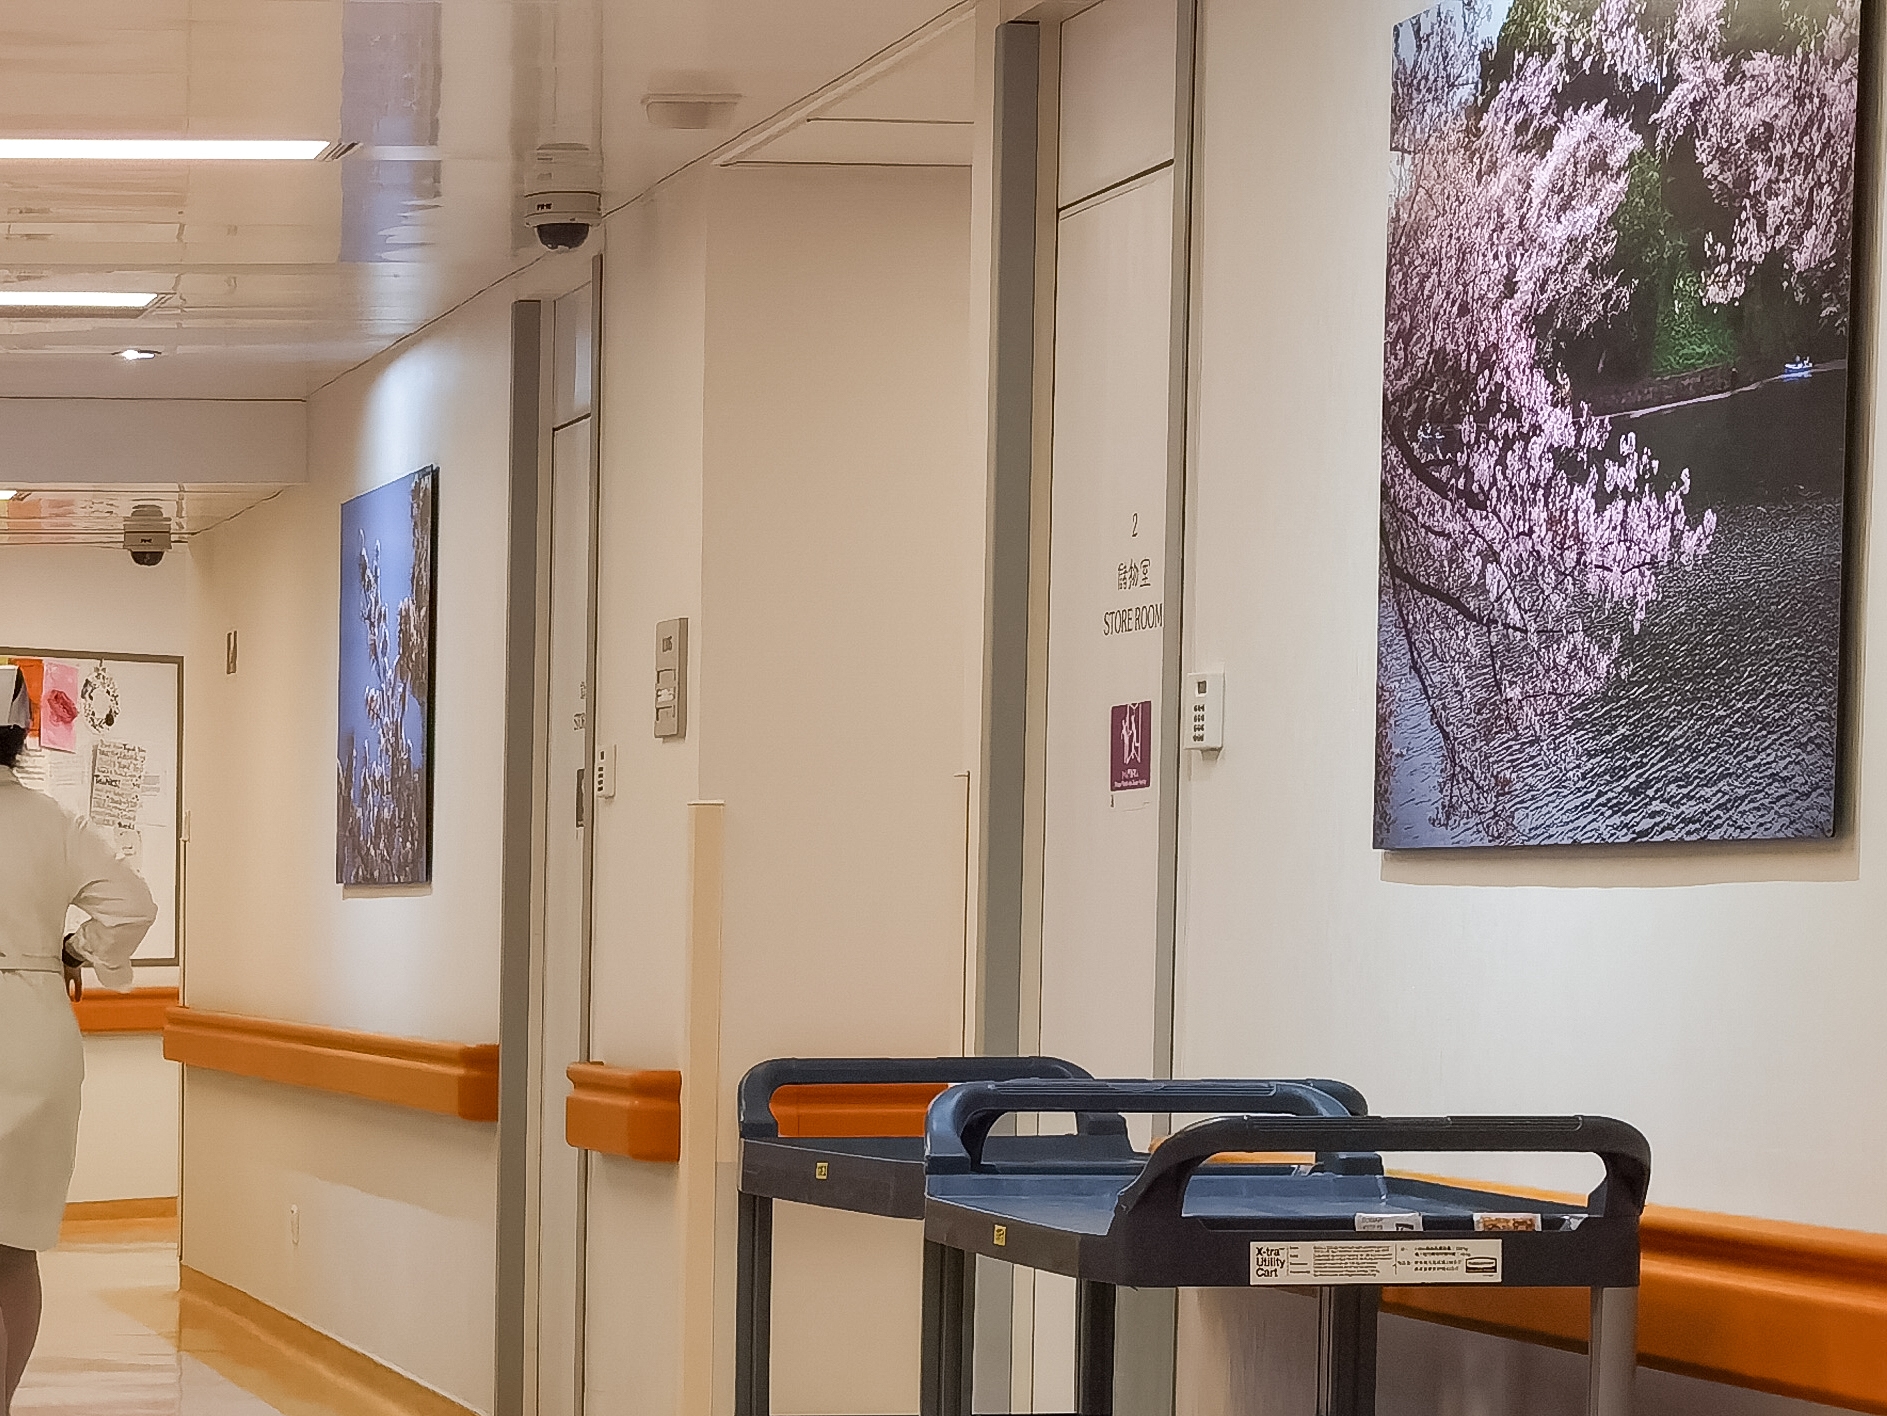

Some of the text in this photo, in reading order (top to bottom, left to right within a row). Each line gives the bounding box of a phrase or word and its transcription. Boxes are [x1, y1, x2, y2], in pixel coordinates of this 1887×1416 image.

[1132, 513, 1138, 537] 2
[1103, 603, 1163, 636] STORE ROOM
[1255, 1257, 1286, 1269] Utility
[1255, 1267, 1279, 1278] Cart
